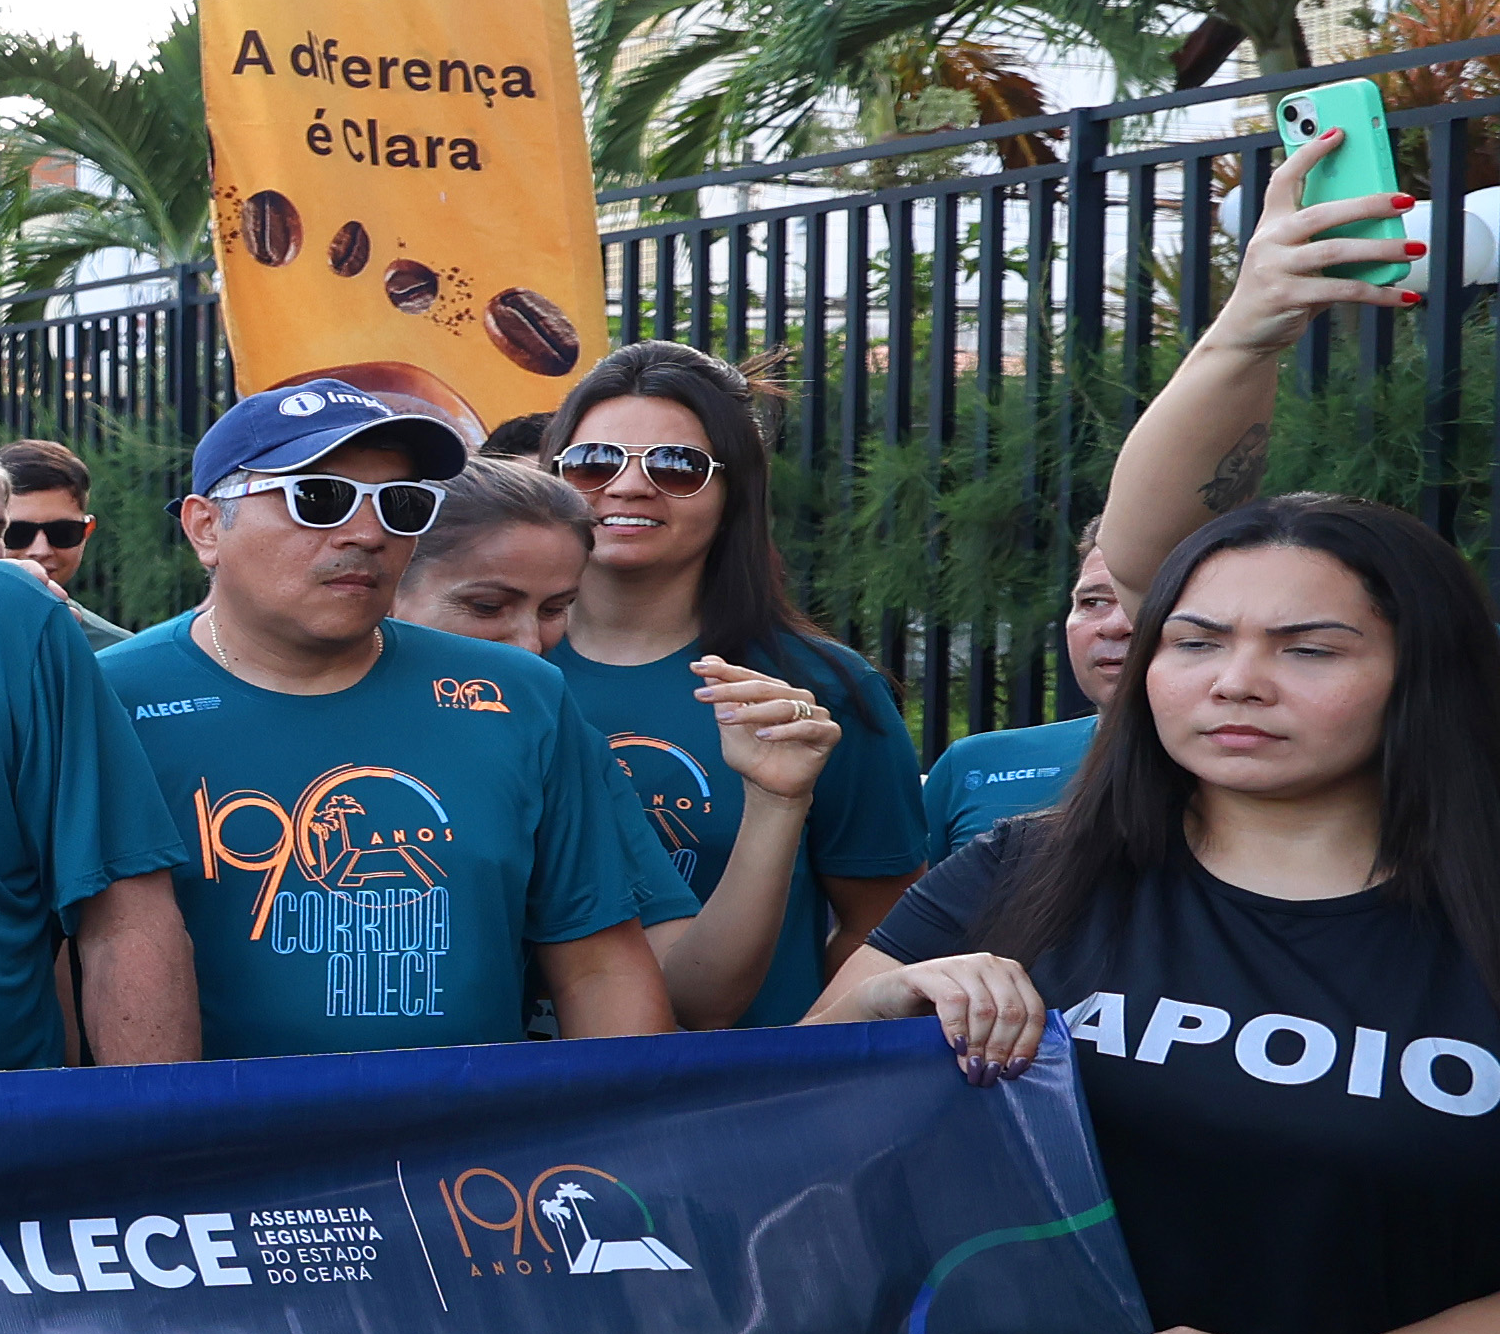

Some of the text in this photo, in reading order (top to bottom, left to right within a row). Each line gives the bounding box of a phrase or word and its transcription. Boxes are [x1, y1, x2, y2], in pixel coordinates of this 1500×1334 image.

[233, 29, 276, 78] A
[306, 109, 482, 172] é Clara
[135, 698, 194, 721] ALECE
[986, 768, 1035, 785] ALECE
[650, 794, 712, 813] NOS
[370, 828, 454, 845] ANOS
[270, 886, 450, 954] CORRIDA
[326, 951, 448, 1018] ALECE
[1066, 991, 1500, 1117] APOIO
[249, 1207, 373, 1228] ASSEMBLEIA
[253, 1226, 383, 1246] LEGISLATIVA
[261, 1246, 377, 1265] DO ESTADO
[267, 1262, 373, 1284] DO CEARÁ
[470, 1258, 555, 1278] ANOS
